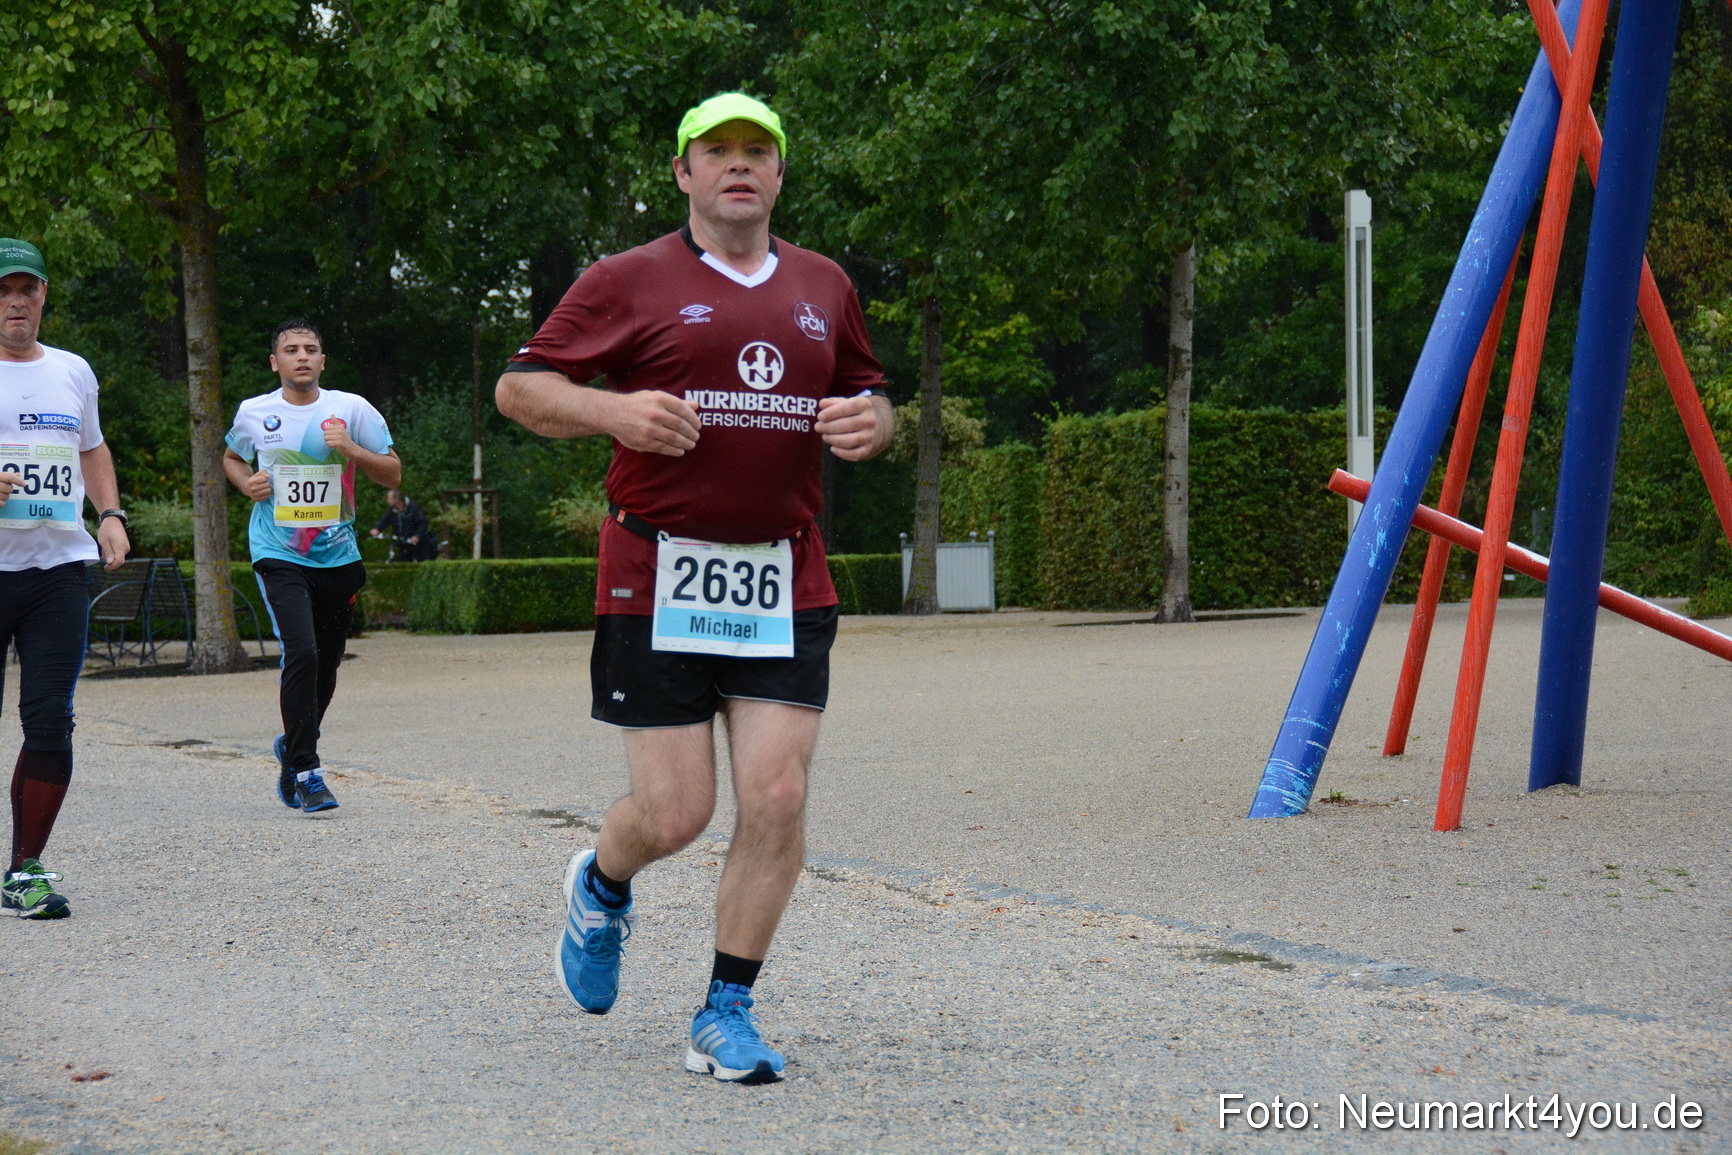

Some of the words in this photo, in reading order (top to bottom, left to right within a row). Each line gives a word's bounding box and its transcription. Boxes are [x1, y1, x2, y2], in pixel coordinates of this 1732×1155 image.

[800, 316, 826, 334] FCN
[684, 389, 818, 417] NÜRNBERGER
[697, 412, 810, 433] ERSICHERUNG
[36, 446, 73, 458] BOCK
[304, 467, 334, 476] BOCK
[288, 481, 329, 504] 307
[29, 504, 53, 517] Udo
[294, 510, 323, 519] Karam
[672, 556, 780, 610] 2636
[689, 616, 758, 639] Michael
[612, 690, 625, 702] sky
